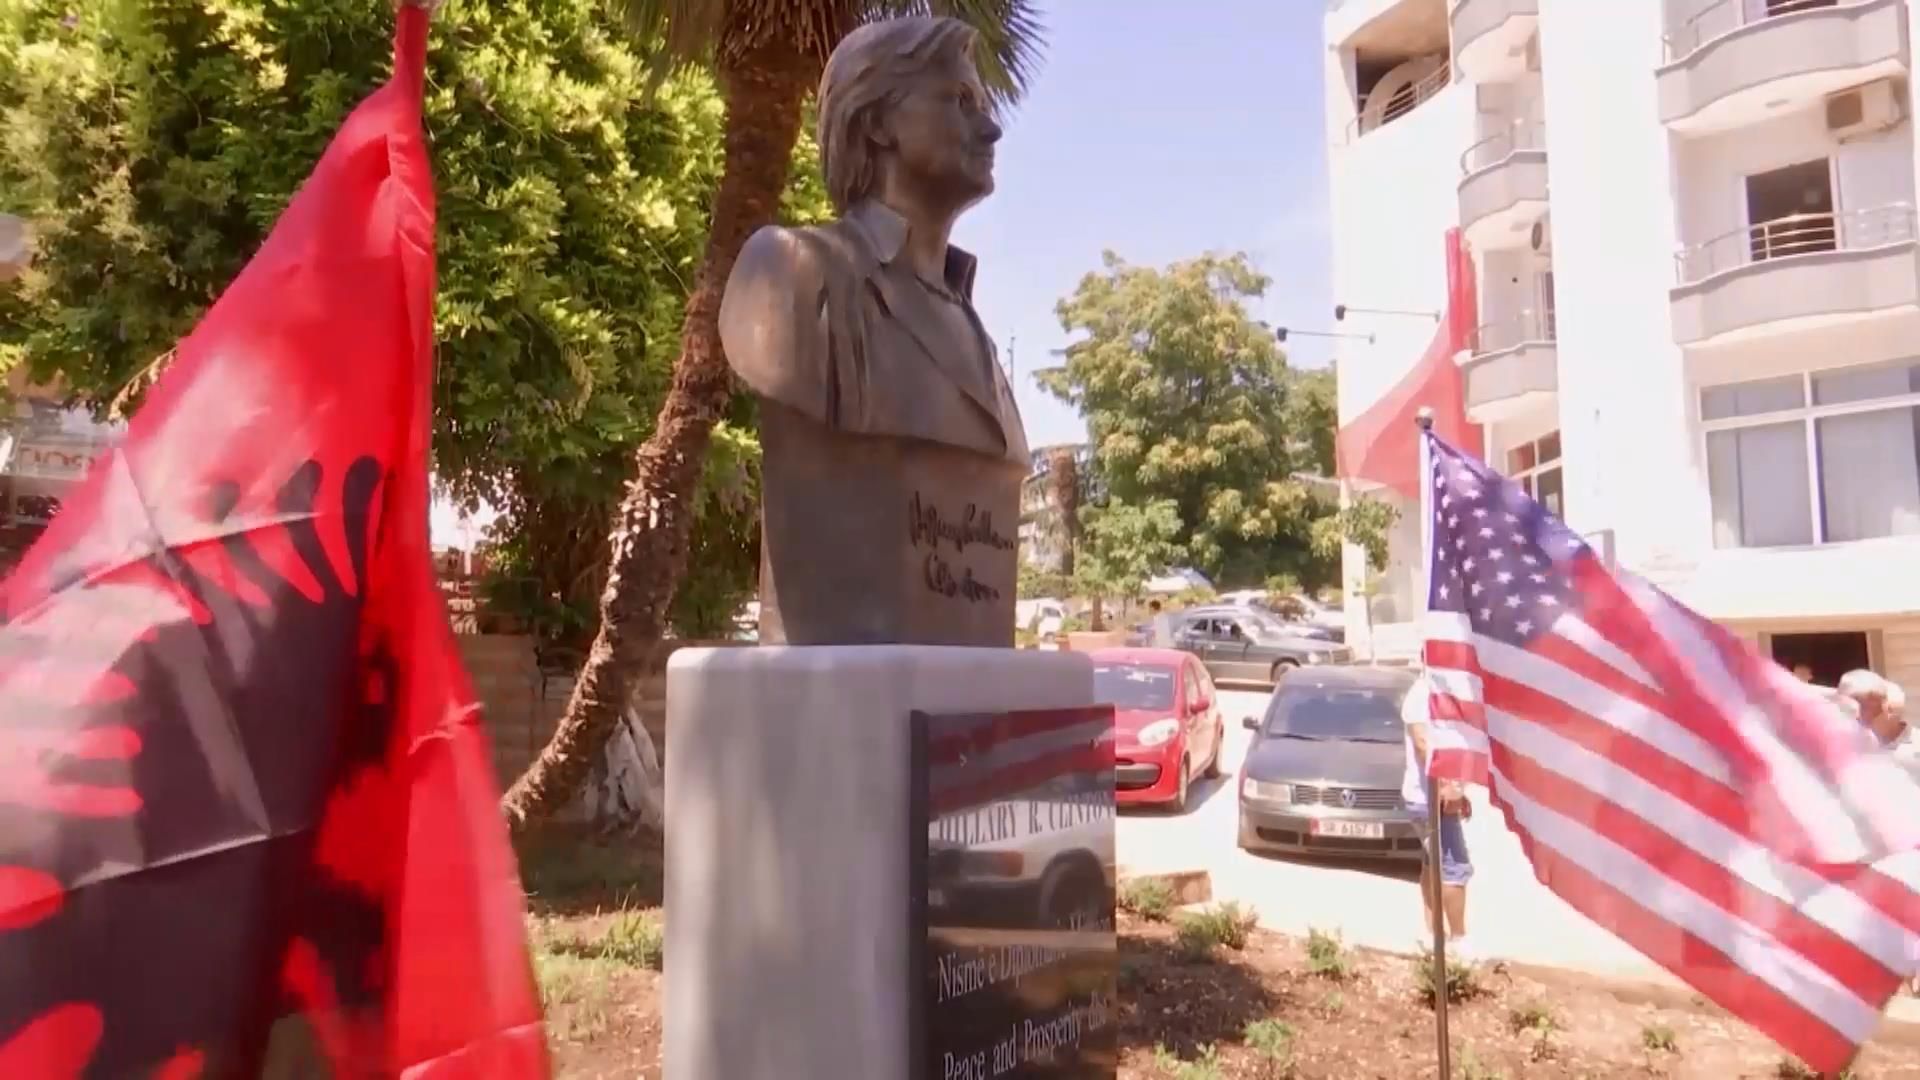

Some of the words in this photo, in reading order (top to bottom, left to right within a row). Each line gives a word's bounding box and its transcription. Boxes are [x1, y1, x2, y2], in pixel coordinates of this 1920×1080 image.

[938, 802, 1017, 845] HILLARY
[1028, 800, 1043, 834] R.
[988, 952, 997, 985] e
[944, 1050, 985, 1080] Peace
[993, 1022, 1017, 1076] and
[1024, 1000, 1082, 1062] Prosperity
